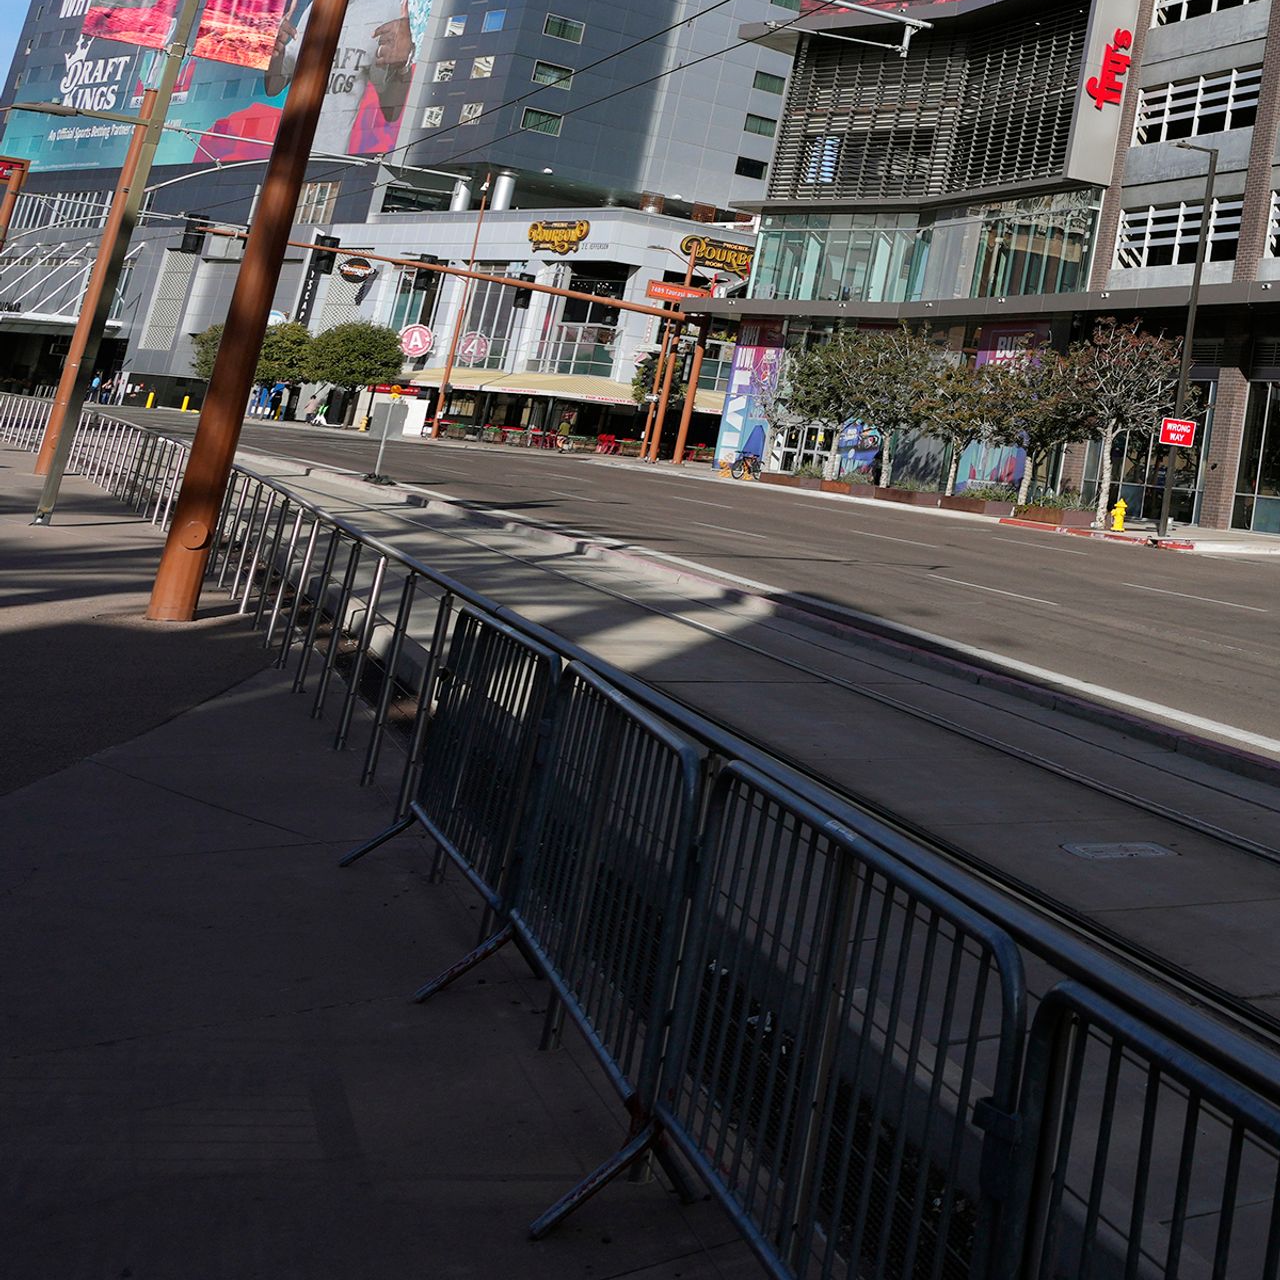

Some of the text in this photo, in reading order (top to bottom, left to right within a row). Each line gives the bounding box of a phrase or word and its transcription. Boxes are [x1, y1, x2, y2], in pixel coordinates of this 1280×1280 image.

[332, 48, 367, 70] AFT
[1086, 28, 1132, 112] fry's
[60, 56, 131, 93] DRAFT
[327, 73, 356, 95] NGS
[63, 84, 119, 111] KINGS
[47, 129, 56, 141] An
[74, 126, 92, 141] Sports
[110, 123, 131, 136] Partner
[681, 236, 753, 266] BOURB
[408, 331, 423, 349] A
[1167, 423, 1191, 433] WRONG
[1170, 433, 1185, 442] WAY
